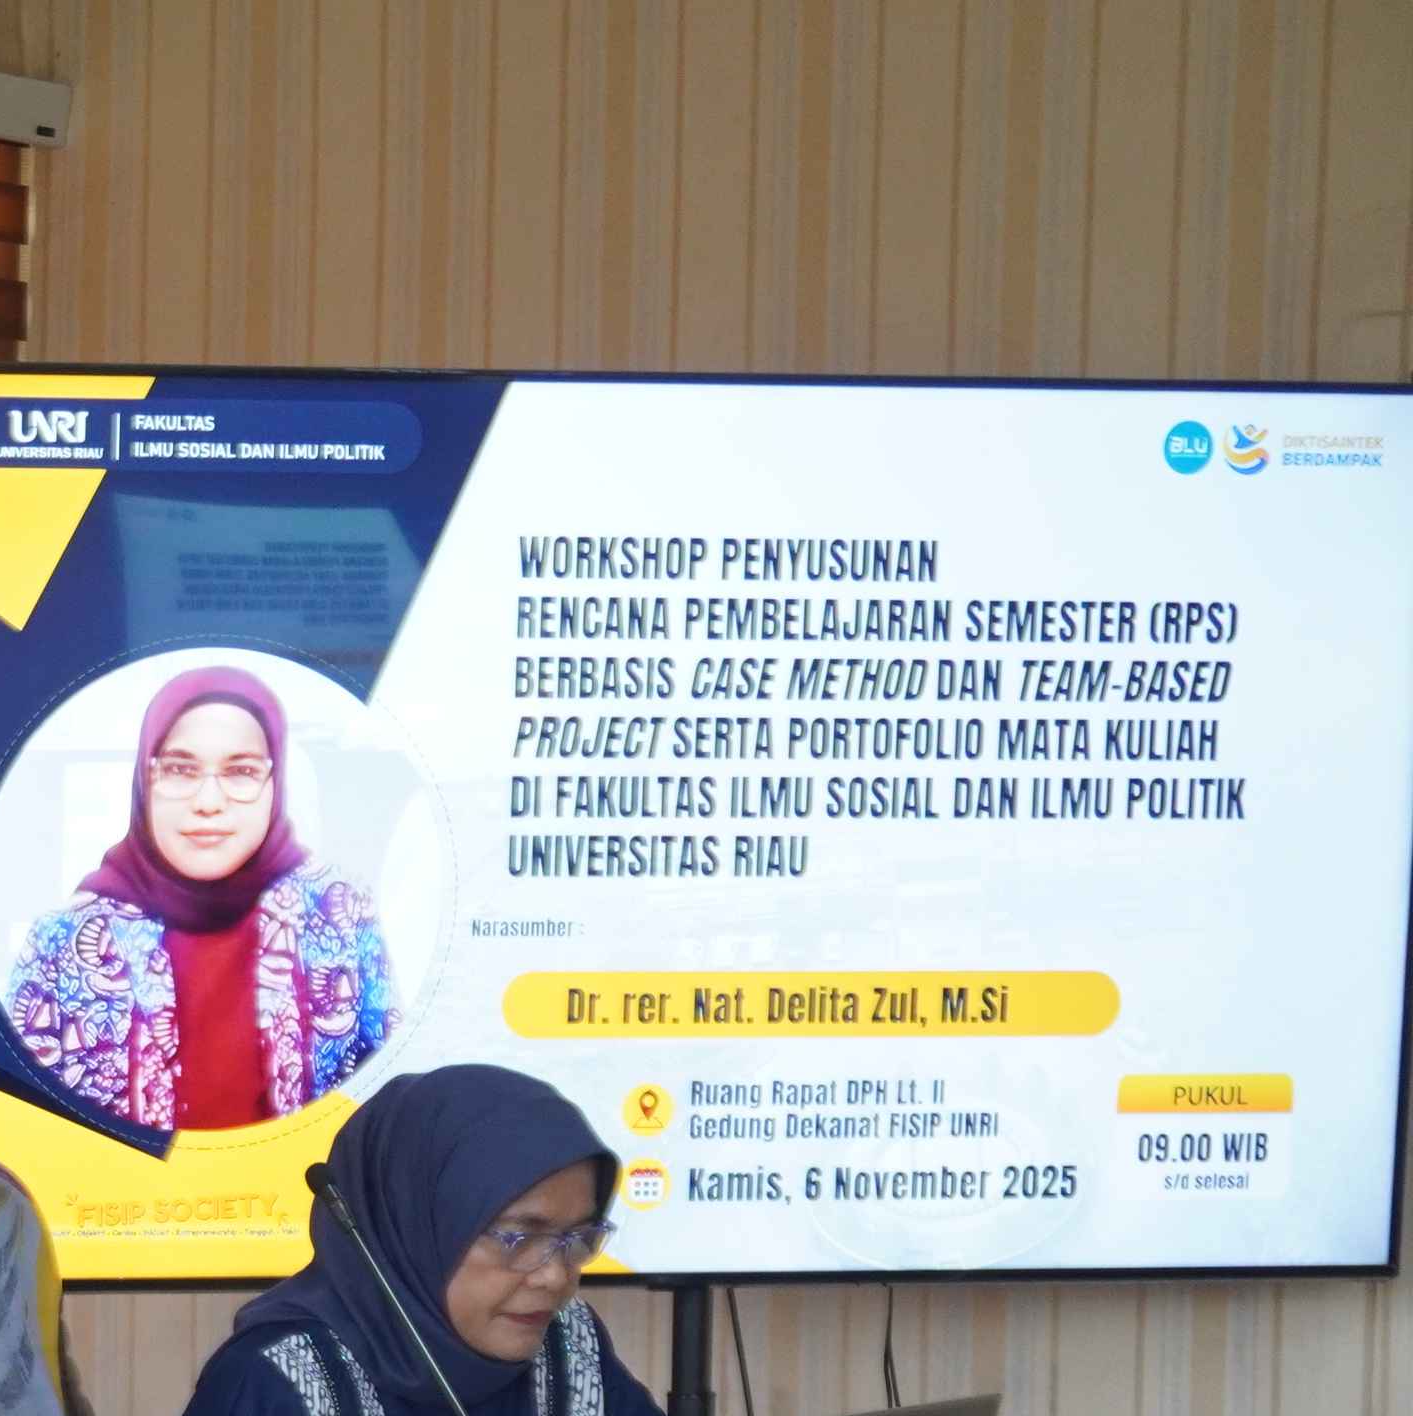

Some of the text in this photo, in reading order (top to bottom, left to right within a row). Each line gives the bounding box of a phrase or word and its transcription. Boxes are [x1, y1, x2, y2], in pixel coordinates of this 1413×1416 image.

[7, 409, 89, 444] UNRI
[132, 414, 216, 432] FAKULTAS
[75, 446, 105, 460] RIAU
[130, 441, 386, 461] ILMU SOSIAL DAN ILMU POLITIK
[1282, 434, 1384, 450] DIKTISAINTEK
[1282, 452, 1382, 468] BERDAMPAK
[519, 535, 939, 583] WORKSHOP PENYUSUNAN
[516, 596, 1238, 645] RENCANA PEMBELAJARAN SEMESTER (RPS)
[514, 657, 1232, 703] BERBASIS CASE METHOD DAN TEAM-BASED
[513, 716, 1219, 762] PROJECT SERTA PORTOFOLIO MATA KULIAH
[510, 775, 1246, 821] DI FAKULTAS ILMU SOSIAL DAN ILMU POLITIK
[508, 835, 808, 879] UNIVERSITAS RIAU
[473, 918, 572, 938] Narasumber
[568, 986, 1009, 1028] Dr. rer. Nat. Delita Zul, M.Si
[691, 1080, 946, 1108] Ruang Rapat DPH Lt. II
[1173, 1086, 1247, 1105] PUKUL
[690, 1113, 999, 1141] Gedung Dekanat FISIP UNRI
[1138, 1132, 1269, 1162] 09.00 WIB
[688, 1166, 1078, 1204] Kamis, 6 November 2025
[1164, 1173, 1249, 1189] s/d selesai
[76, 1193, 279, 1228] FISIP SOCIETY
